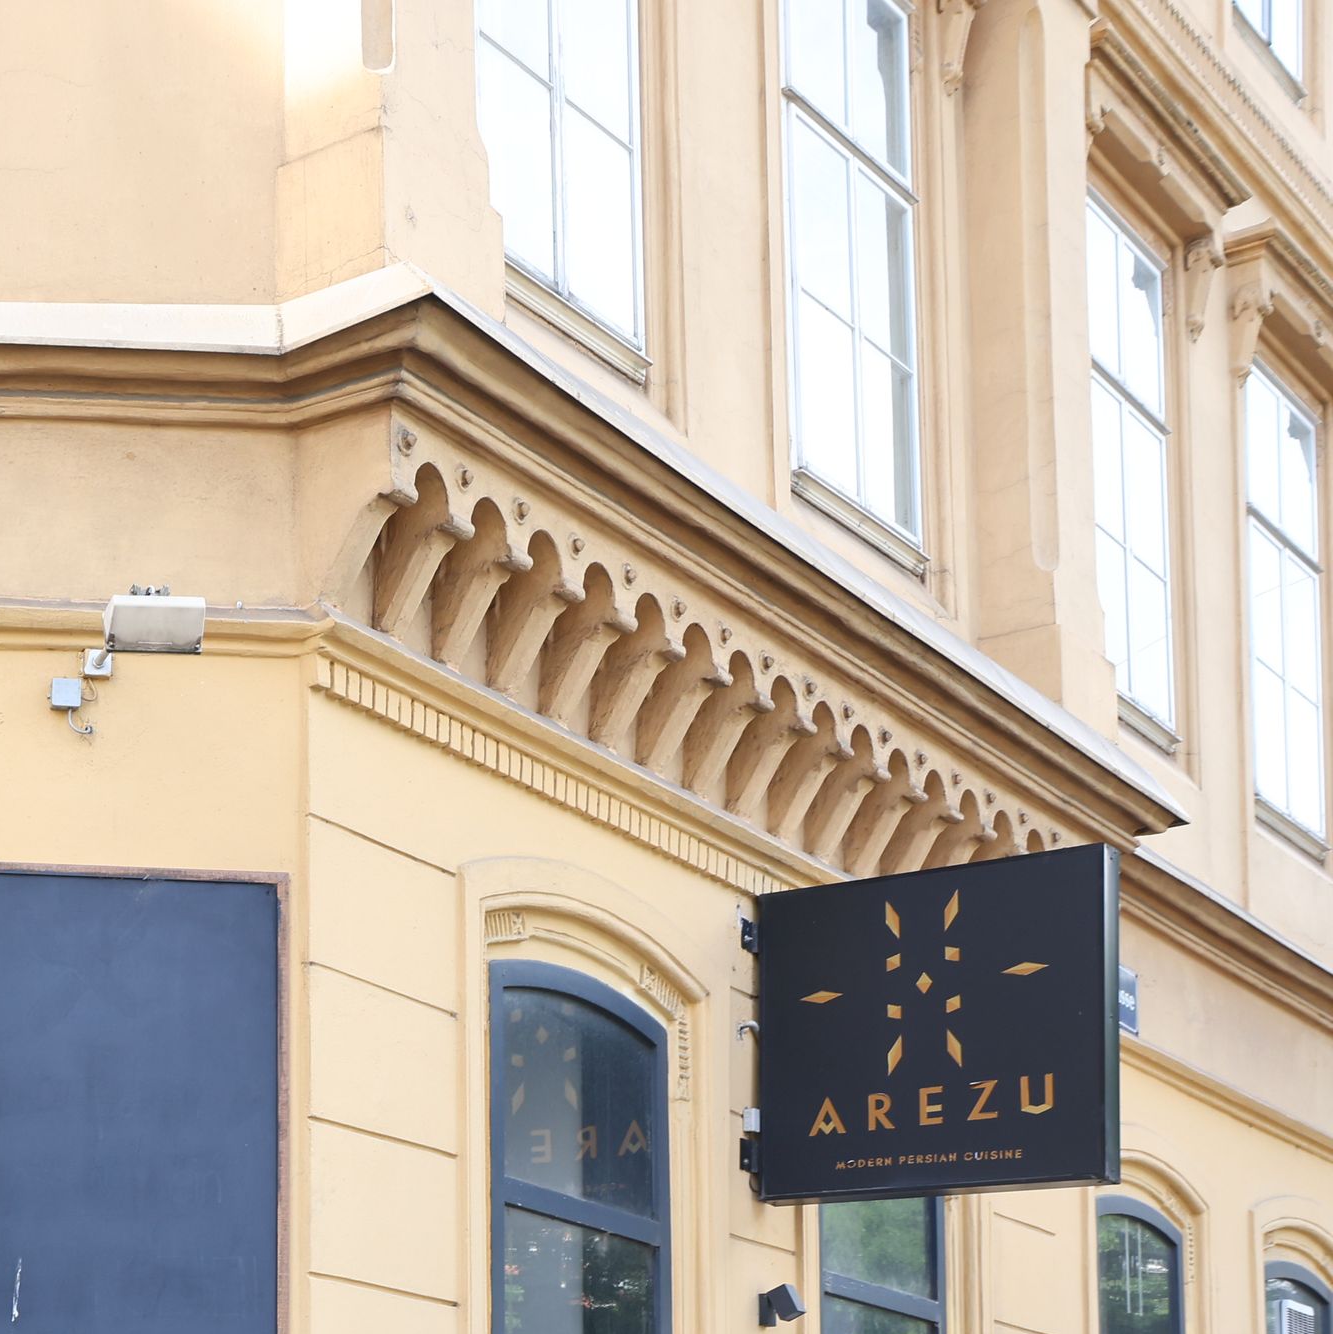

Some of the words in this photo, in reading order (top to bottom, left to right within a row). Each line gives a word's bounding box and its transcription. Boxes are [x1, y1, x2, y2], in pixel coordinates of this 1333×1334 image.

[808, 1072, 1053, 1136] AREZU
[835, 1157, 893, 1170] MODERN
[899, 1152, 957, 1165] PERSIAN
[964, 1149, 1023, 1161] CUISINE
